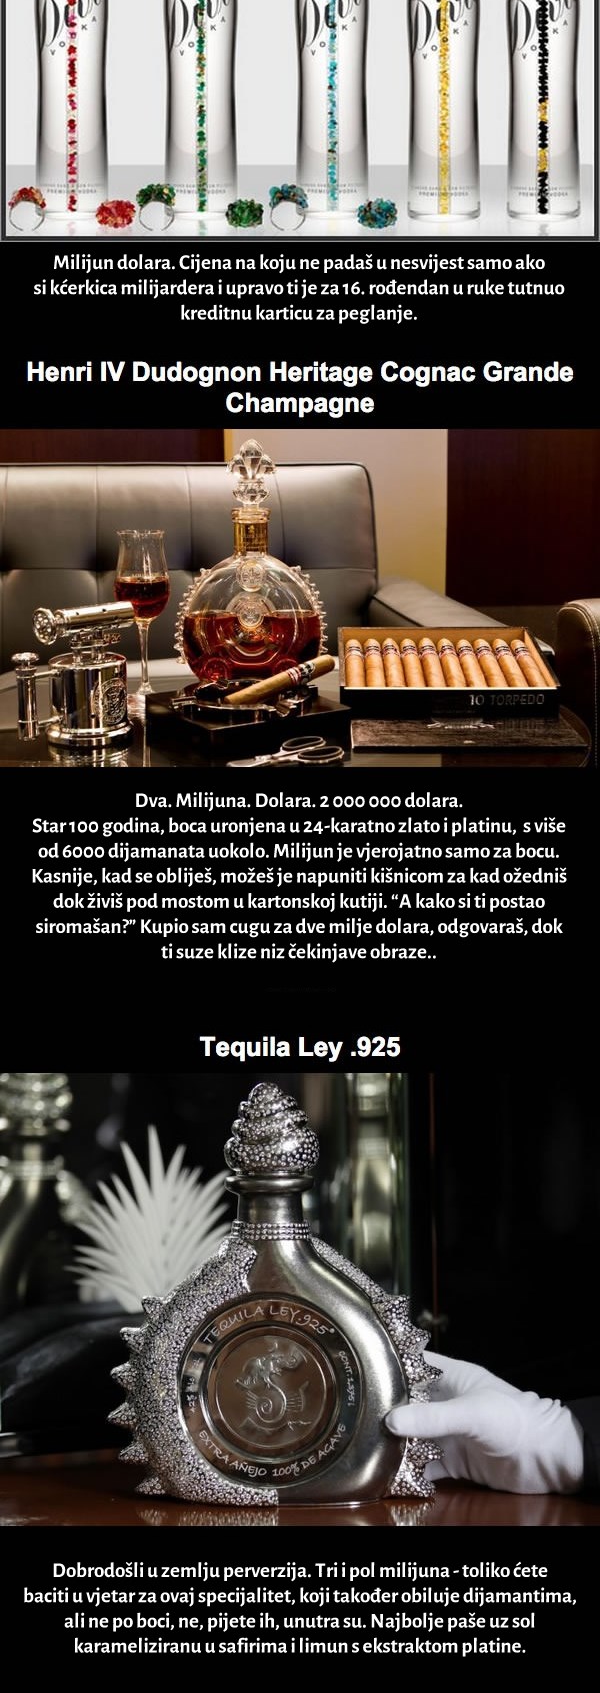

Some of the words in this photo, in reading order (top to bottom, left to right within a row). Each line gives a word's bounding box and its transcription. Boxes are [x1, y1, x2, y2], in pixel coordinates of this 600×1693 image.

[469, 694, 485, 706] 10
[490, 694, 545, 706] TORPEDO
[203, 1306, 264, 1344] TEQUILA
[199, 1429, 230, 1464] EXTRA
[229, 1458, 268, 1478] AÑEJO
[272, 1462, 300, 1477] 100%
[301, 1455, 318, 1470] DE
[318, 1423, 347, 1461] AGAVE
